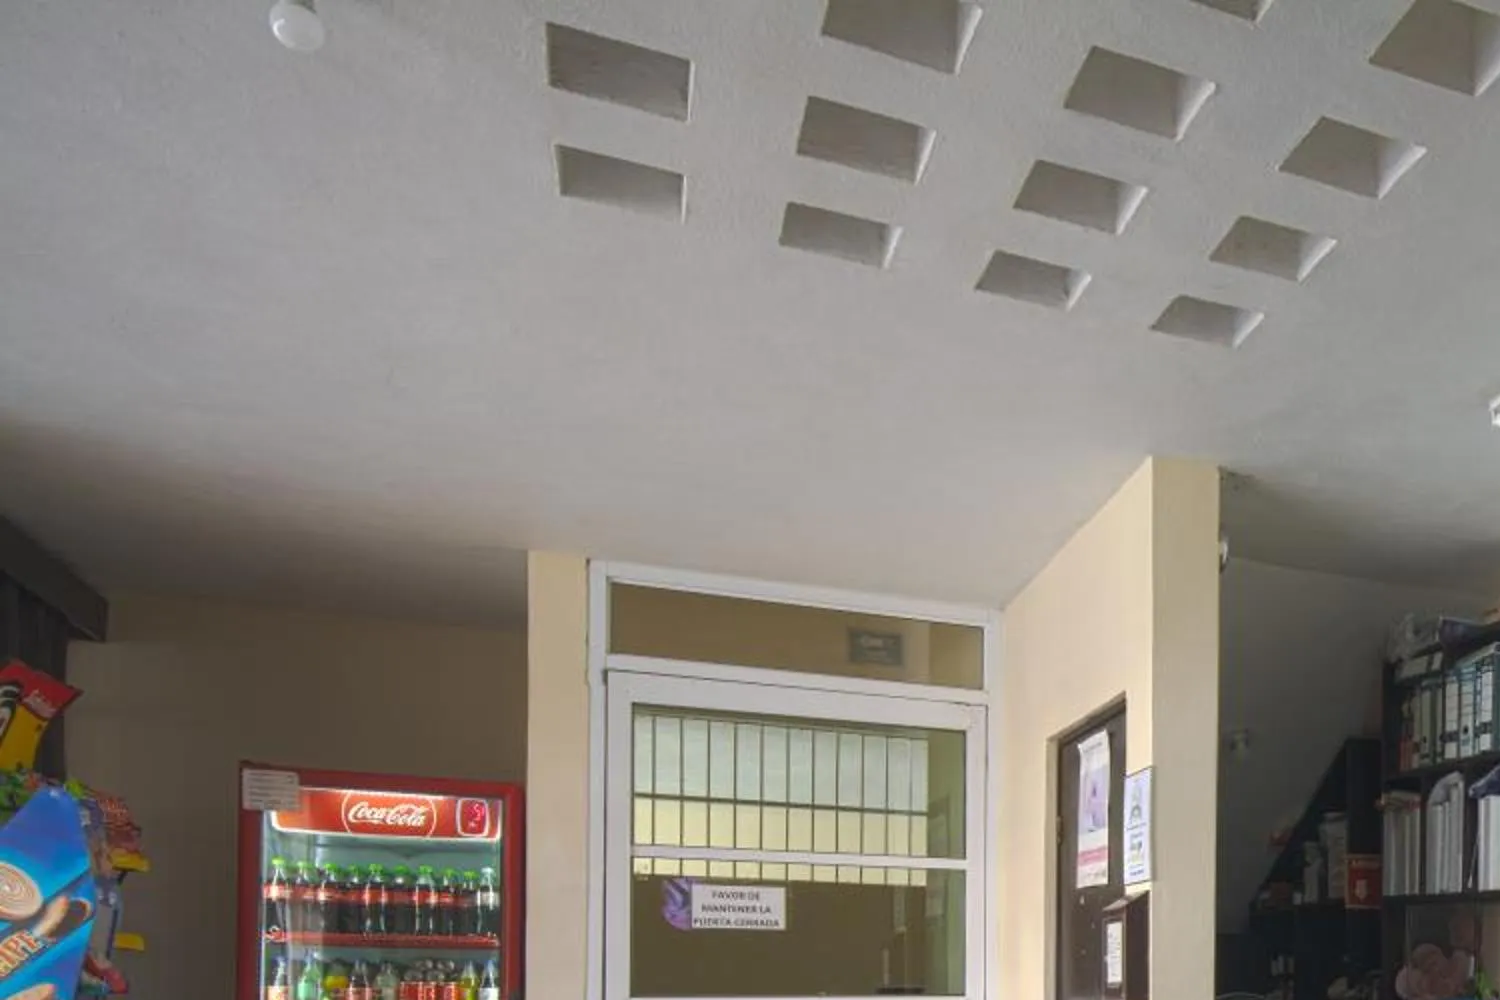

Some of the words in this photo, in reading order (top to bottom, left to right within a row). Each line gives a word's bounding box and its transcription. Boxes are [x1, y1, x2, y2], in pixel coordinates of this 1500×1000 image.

[711, 890, 746, 901] FAVOR
[747, 890, 760, 902] DE
[759, 904, 772, 914] LA
